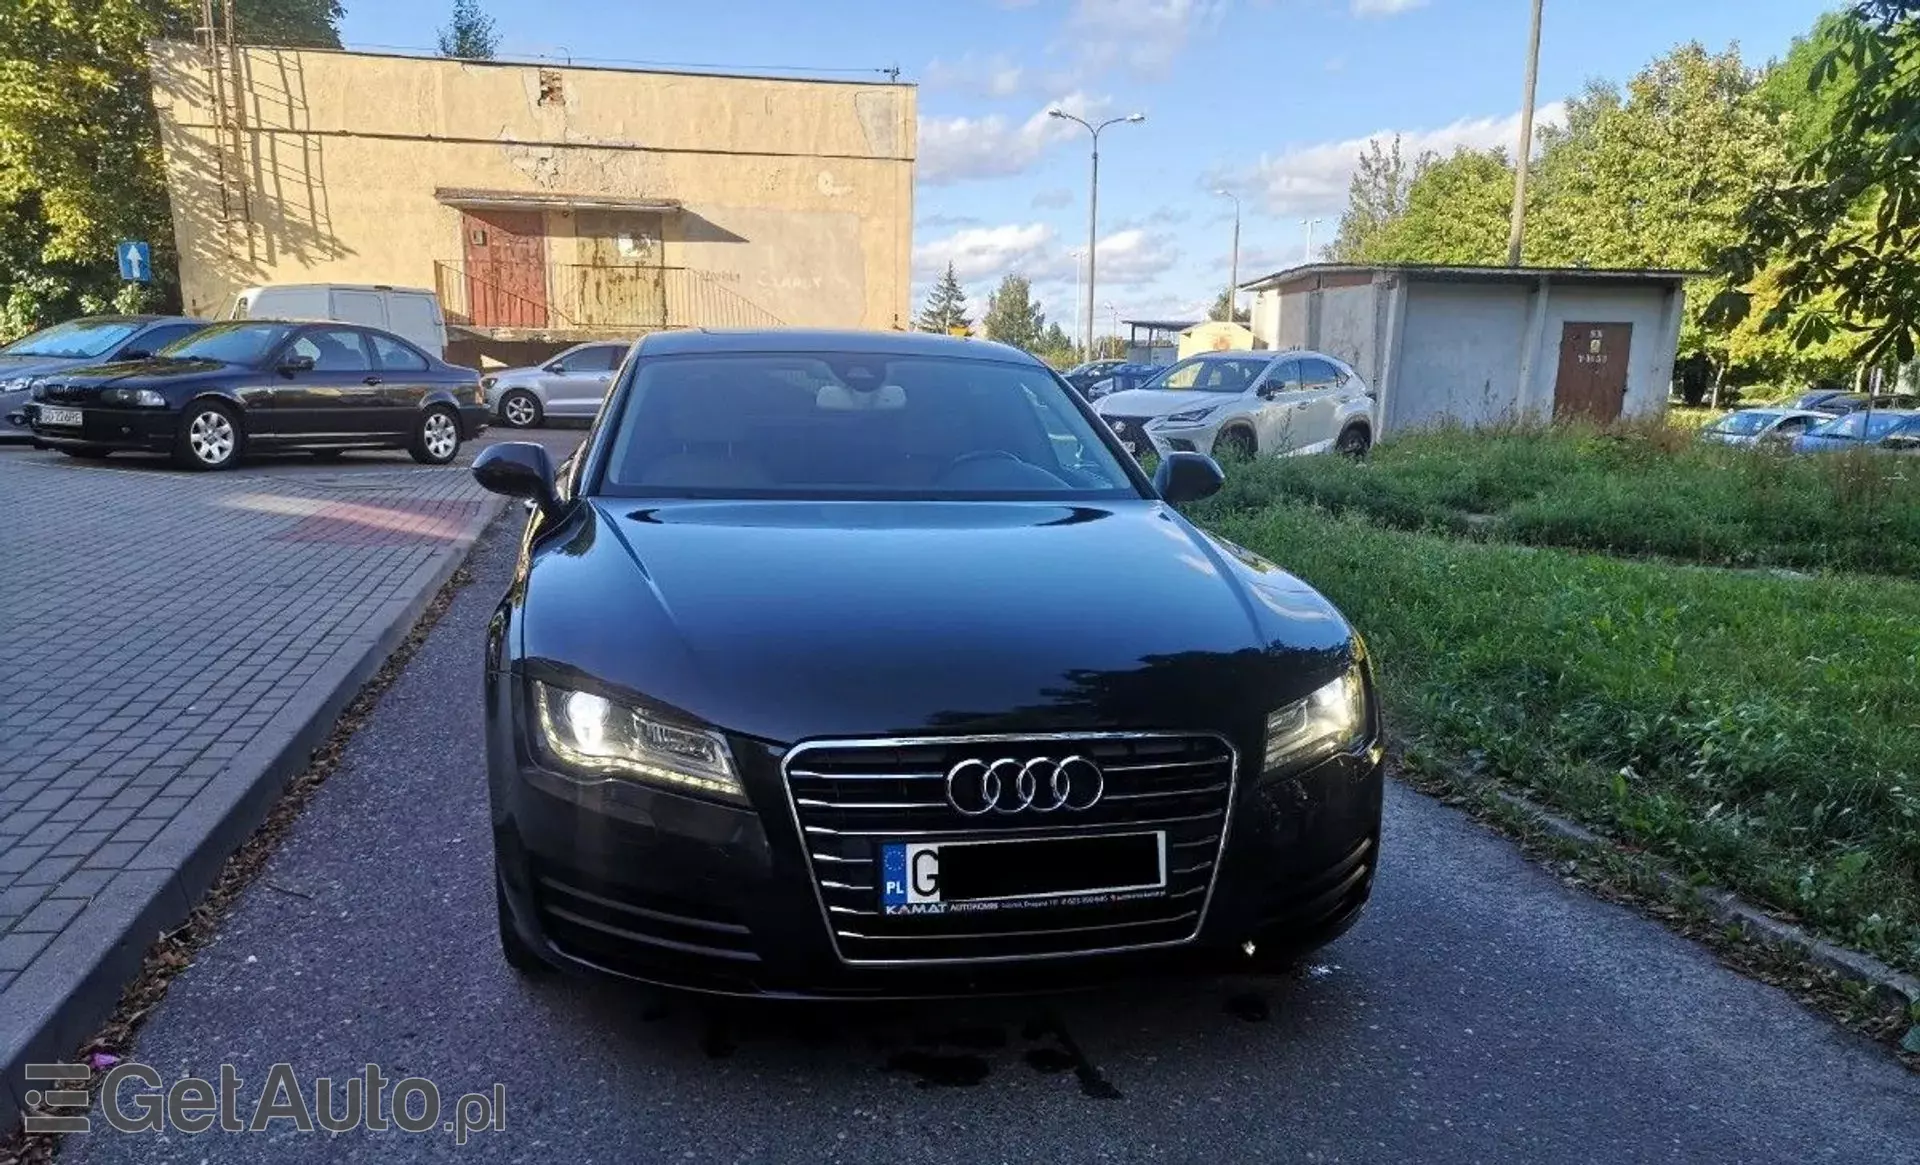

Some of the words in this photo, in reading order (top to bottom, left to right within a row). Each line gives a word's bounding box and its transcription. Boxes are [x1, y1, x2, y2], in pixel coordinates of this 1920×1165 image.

[912, 849, 939, 896] G
[886, 881, 904, 894] PL
[886, 903, 948, 915] KAMAT
